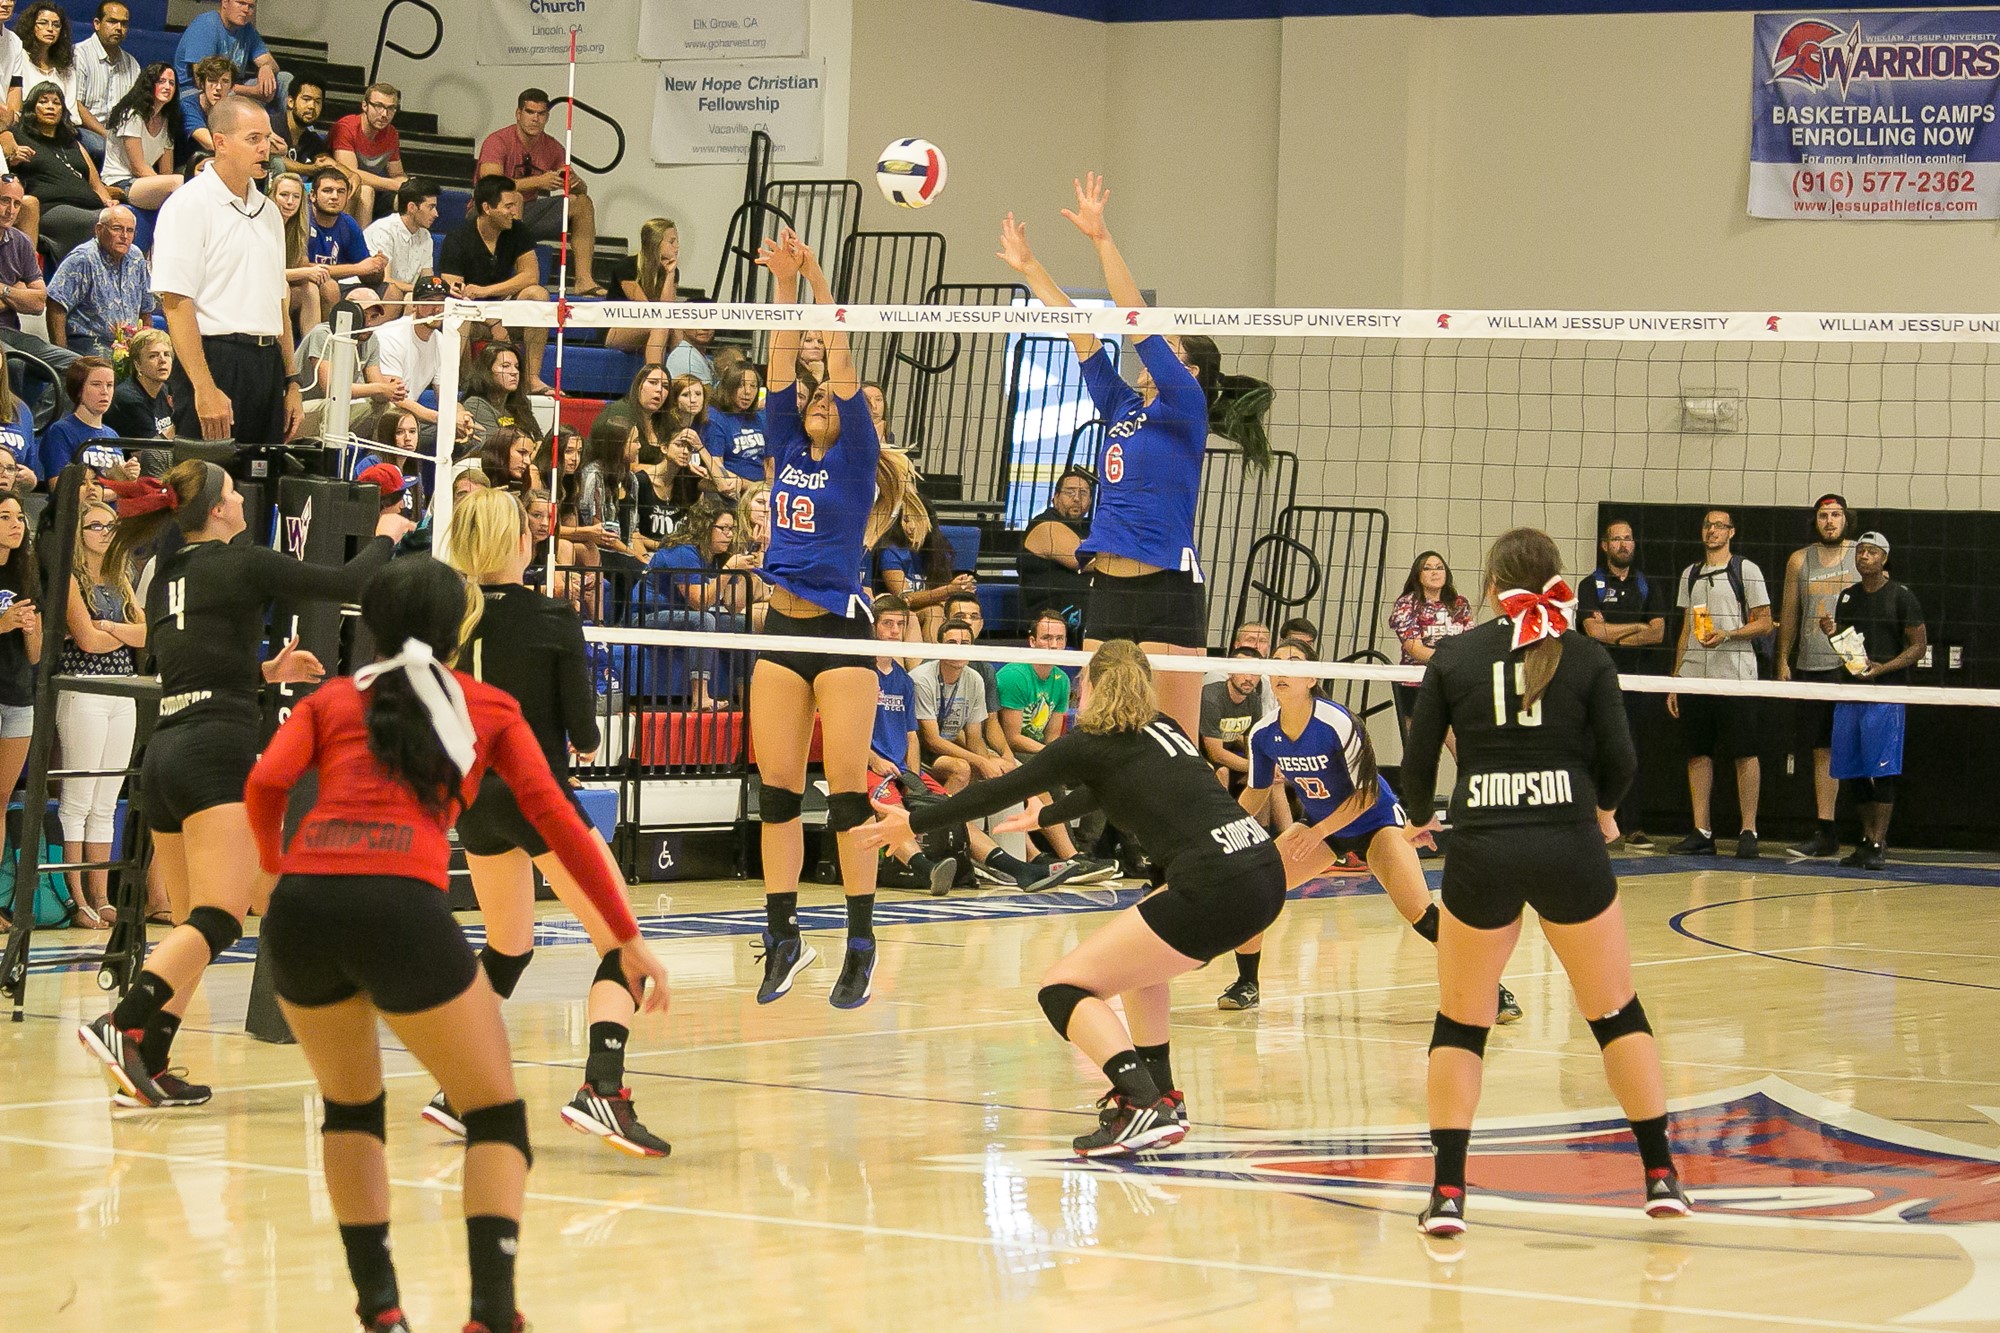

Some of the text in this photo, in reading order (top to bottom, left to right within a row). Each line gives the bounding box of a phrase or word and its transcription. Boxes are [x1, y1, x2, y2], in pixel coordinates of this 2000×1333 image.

[530, 0, 586, 13] Church
[693, 19, 707, 30] Elk
[743, 17, 759, 28] CA
[684, 39, 767, 50] www.goharvest.org
[1943, 33, 1998, 42] UNIVERSITY
[1823, 37, 2000, 92] WARRIORS
[665, 76, 819, 94] New Hope Christian
[698, 97, 780, 113] Fellowship
[1772, 104, 1996, 125] BASKETBALL CAMPS
[1791, 127, 1975, 146] ENROLLING NOW
[1802, 154, 1820, 164] For
[1824, 155, 1853, 164] more
[1925, 154, 1966, 164] contact
[1792, 170, 1975, 198] (916) 577-2362
[1793, 199, 1978, 214] www.jessupathletics.com
[603, 307, 804, 321] WILLIAM JESSUP UNIVERSITY
[880, 310, 1093, 324] WILLIAM JESSUP UNIVERSITY
[1174, 313, 1402, 328] WILLIAM JESSUP UNIVERSITY
[1487, 316, 1729, 331] WILLIAM JESSUP UNIVERSITY
[1819, 318, 1893, 332] WILLIAM
[1899, 319, 1964, 333] JESSUP
[1106, 444, 1124, 483] 6
[775, 491, 815, 533] 12
[168, 577, 186, 630] 4
[1144, 721, 1200, 758] 16
[1277, 754, 1329, 772] JESSUP
[1294, 777, 1331, 799] 17
[1467, 769, 1573, 808] SIMPSON
